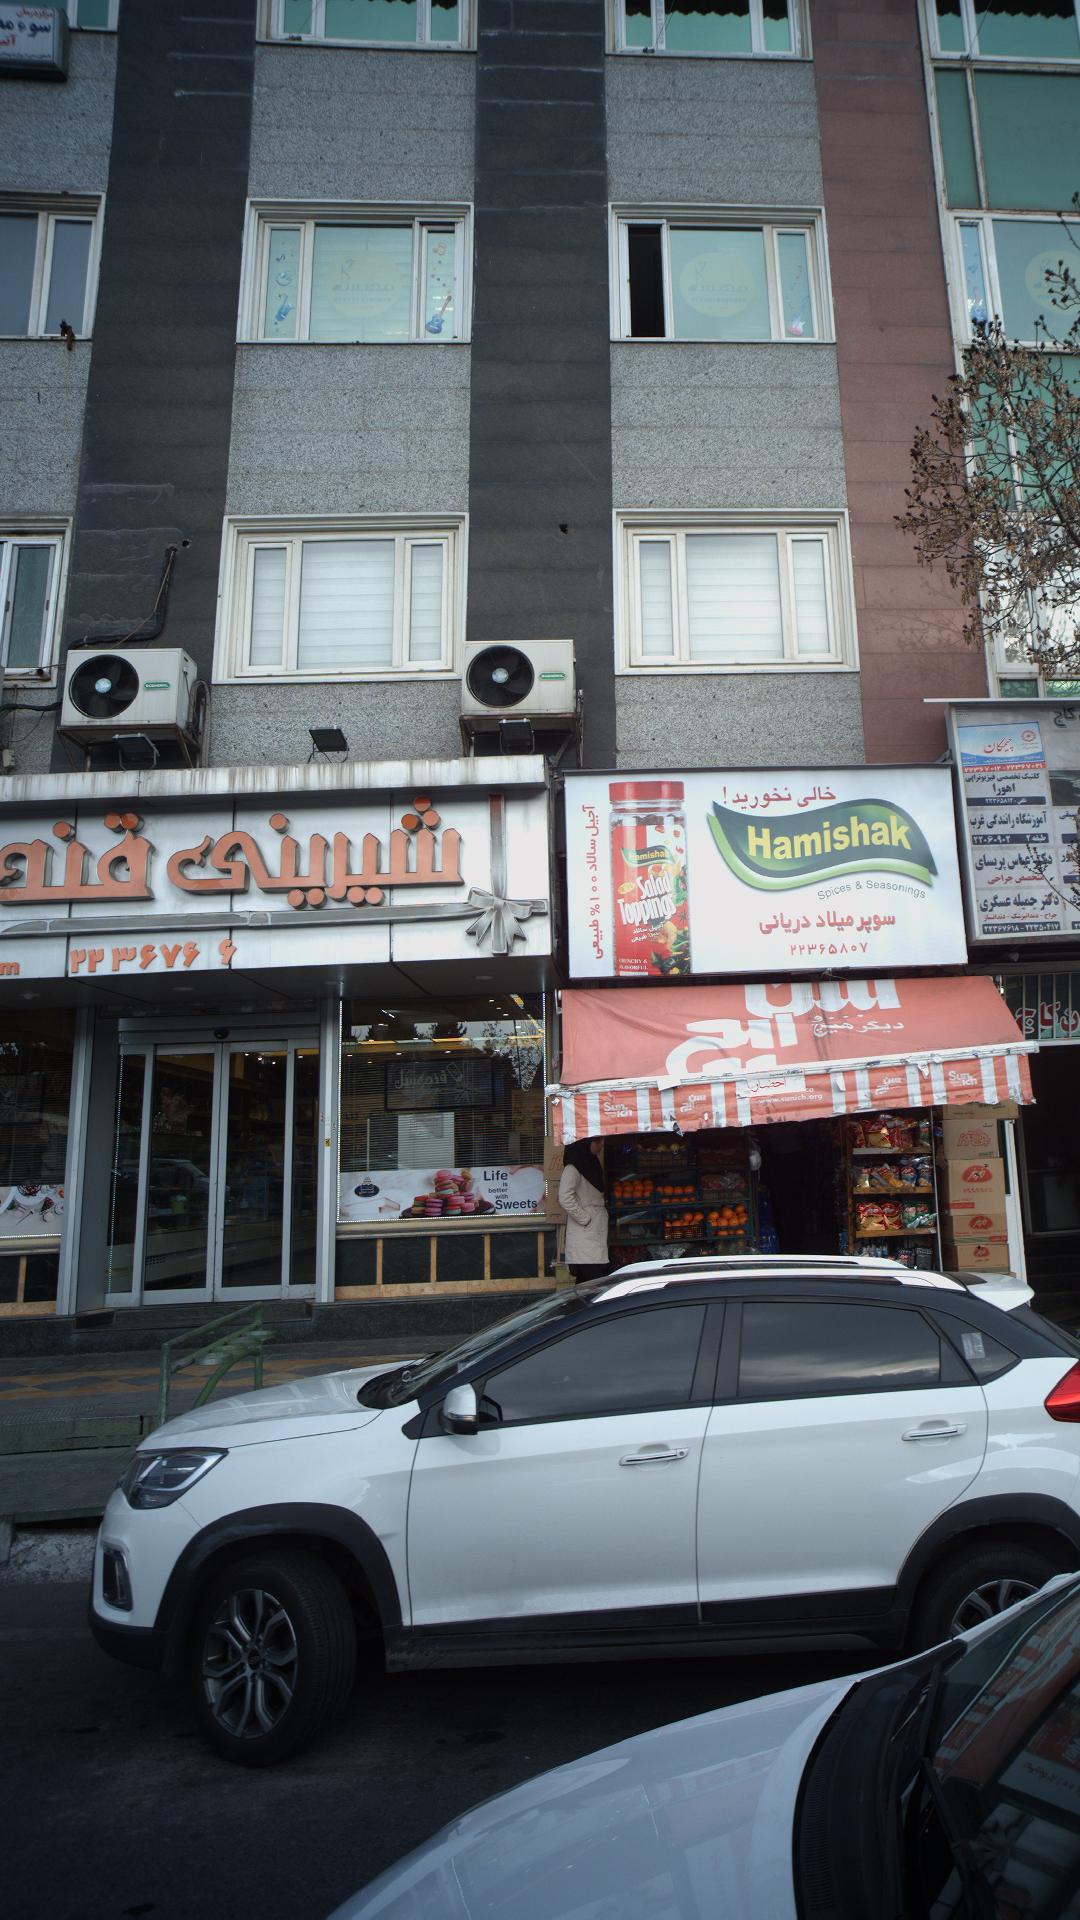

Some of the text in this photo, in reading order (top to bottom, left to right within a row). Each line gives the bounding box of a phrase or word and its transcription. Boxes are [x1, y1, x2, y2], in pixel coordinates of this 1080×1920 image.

[797, 786, 837, 808] خالی
[992, 783, 1016, 796] اهورا
[1016, 811, 1047, 829] آموزشگاه
[747, 815, 912, 860] Hamishak
[167, 796, 464, 909] شیرینی
[587, 839, 597, 872] سالاد
[636, 871, 673, 900] Salad
[817, 879, 926, 900] Spices & Seasonings
[987, 874, 1013, 885] جراحی
[617, 894, 677, 927] Toppings
[1040, 892, 1060, 911] دکتر
[759, 911, 896, 934] سوپر میلاد دریانی
[589, 919, 604, 959] طبیعی
[790, 942, 868, 956] ۲۲۳۶۵۸۰۷
[858, 1018, 905, 1034] دیگر
[483, 1170, 508, 1181] Life
[494, 1199, 538, 1210] Sweets
